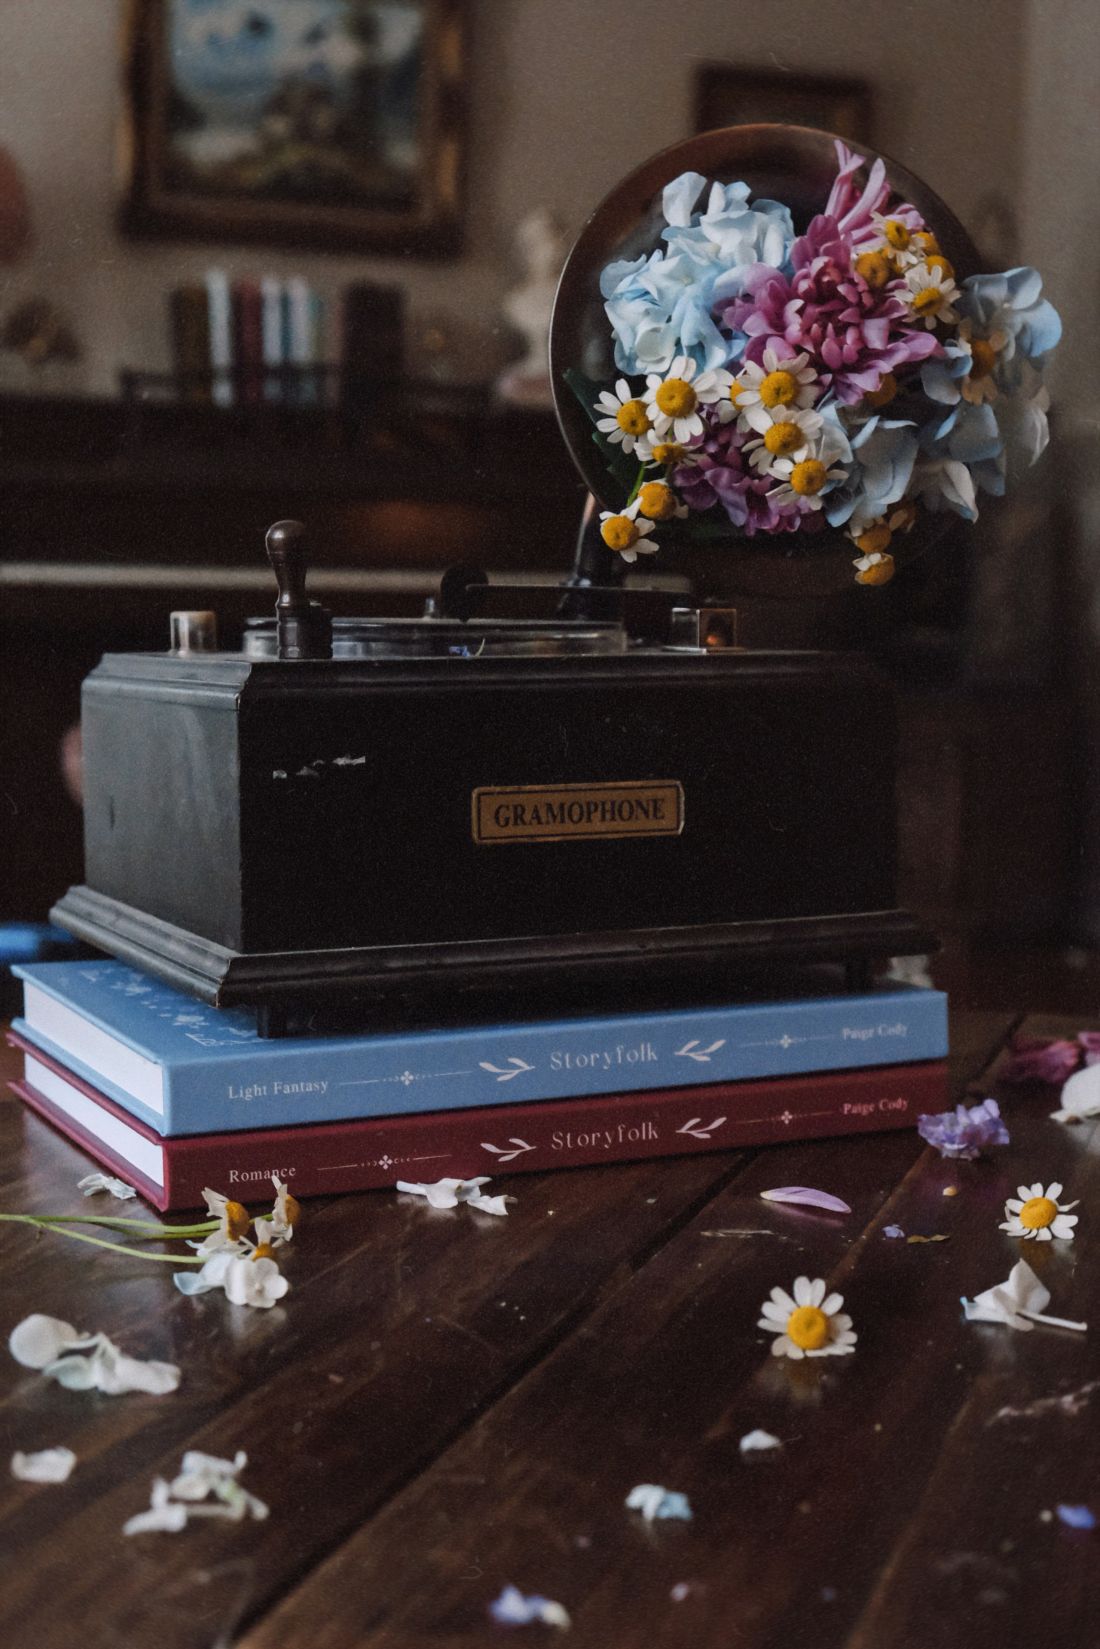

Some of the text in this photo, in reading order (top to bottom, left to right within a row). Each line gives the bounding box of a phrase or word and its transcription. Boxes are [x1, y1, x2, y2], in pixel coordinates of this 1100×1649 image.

[494, 798, 665, 828] GRAMOPHONE
[550, 1043, 658, 1070] Storyfolk
[228, 1080, 329, 1101] Light Fantasy
[551, 1121, 659, 1150] Storyfolk
[229, 1166, 296, 1183] Romance
